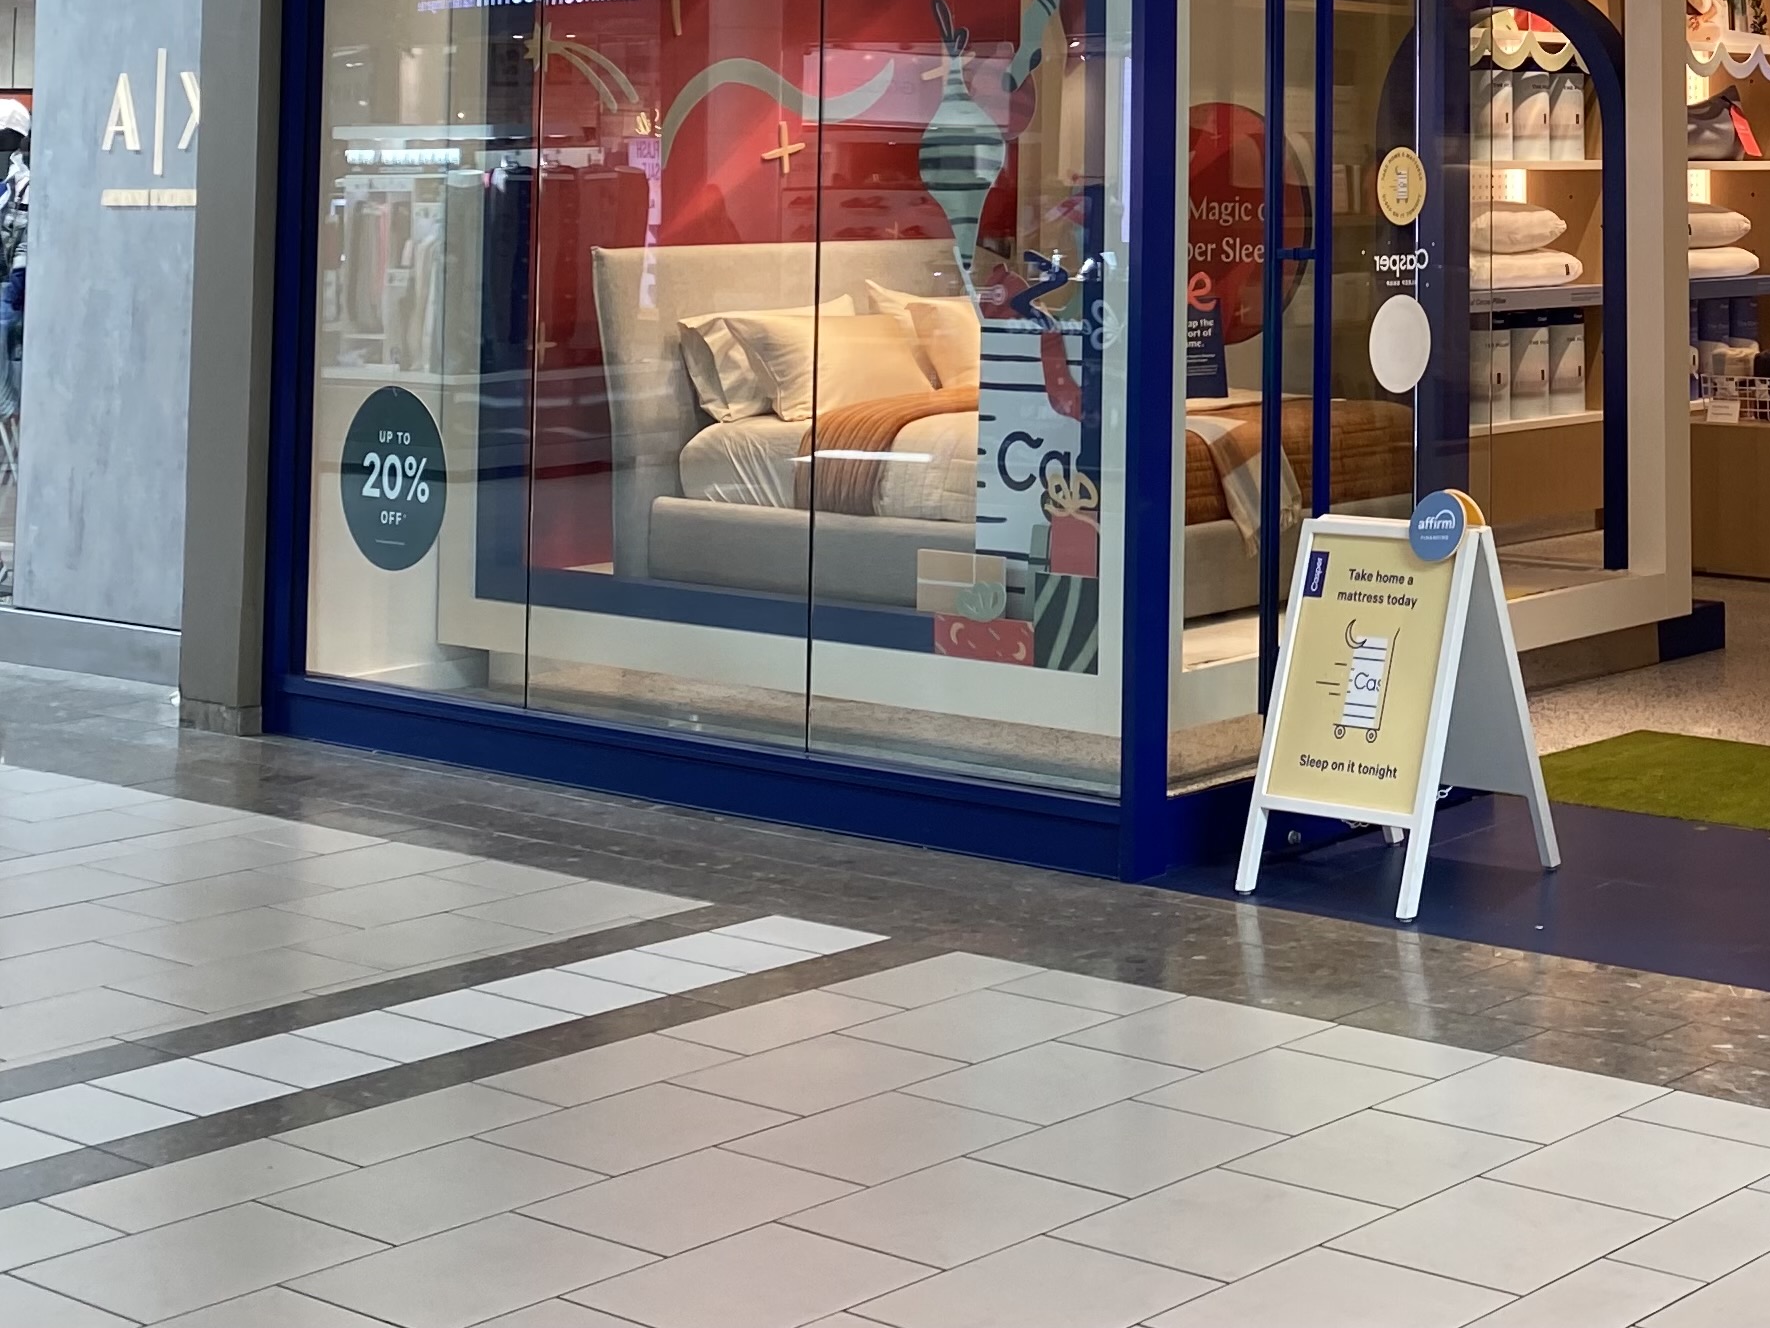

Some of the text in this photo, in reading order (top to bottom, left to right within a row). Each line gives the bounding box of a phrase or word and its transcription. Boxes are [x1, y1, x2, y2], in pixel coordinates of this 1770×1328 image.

[1188, 195, 1253, 226] Magic
[1221, 236, 1265, 264] Slee
[378, 430, 411, 445] UP TO
[361, 452, 430, 503] 20%
[1417, 509, 1456, 530] affirm
[1310, 556, 1323, 592] Casper
[1348, 568, 1414, 586] Take home a
[1337, 589, 1418, 610] mattress today
[1299, 754, 1398, 780] Sleep on it tonight
